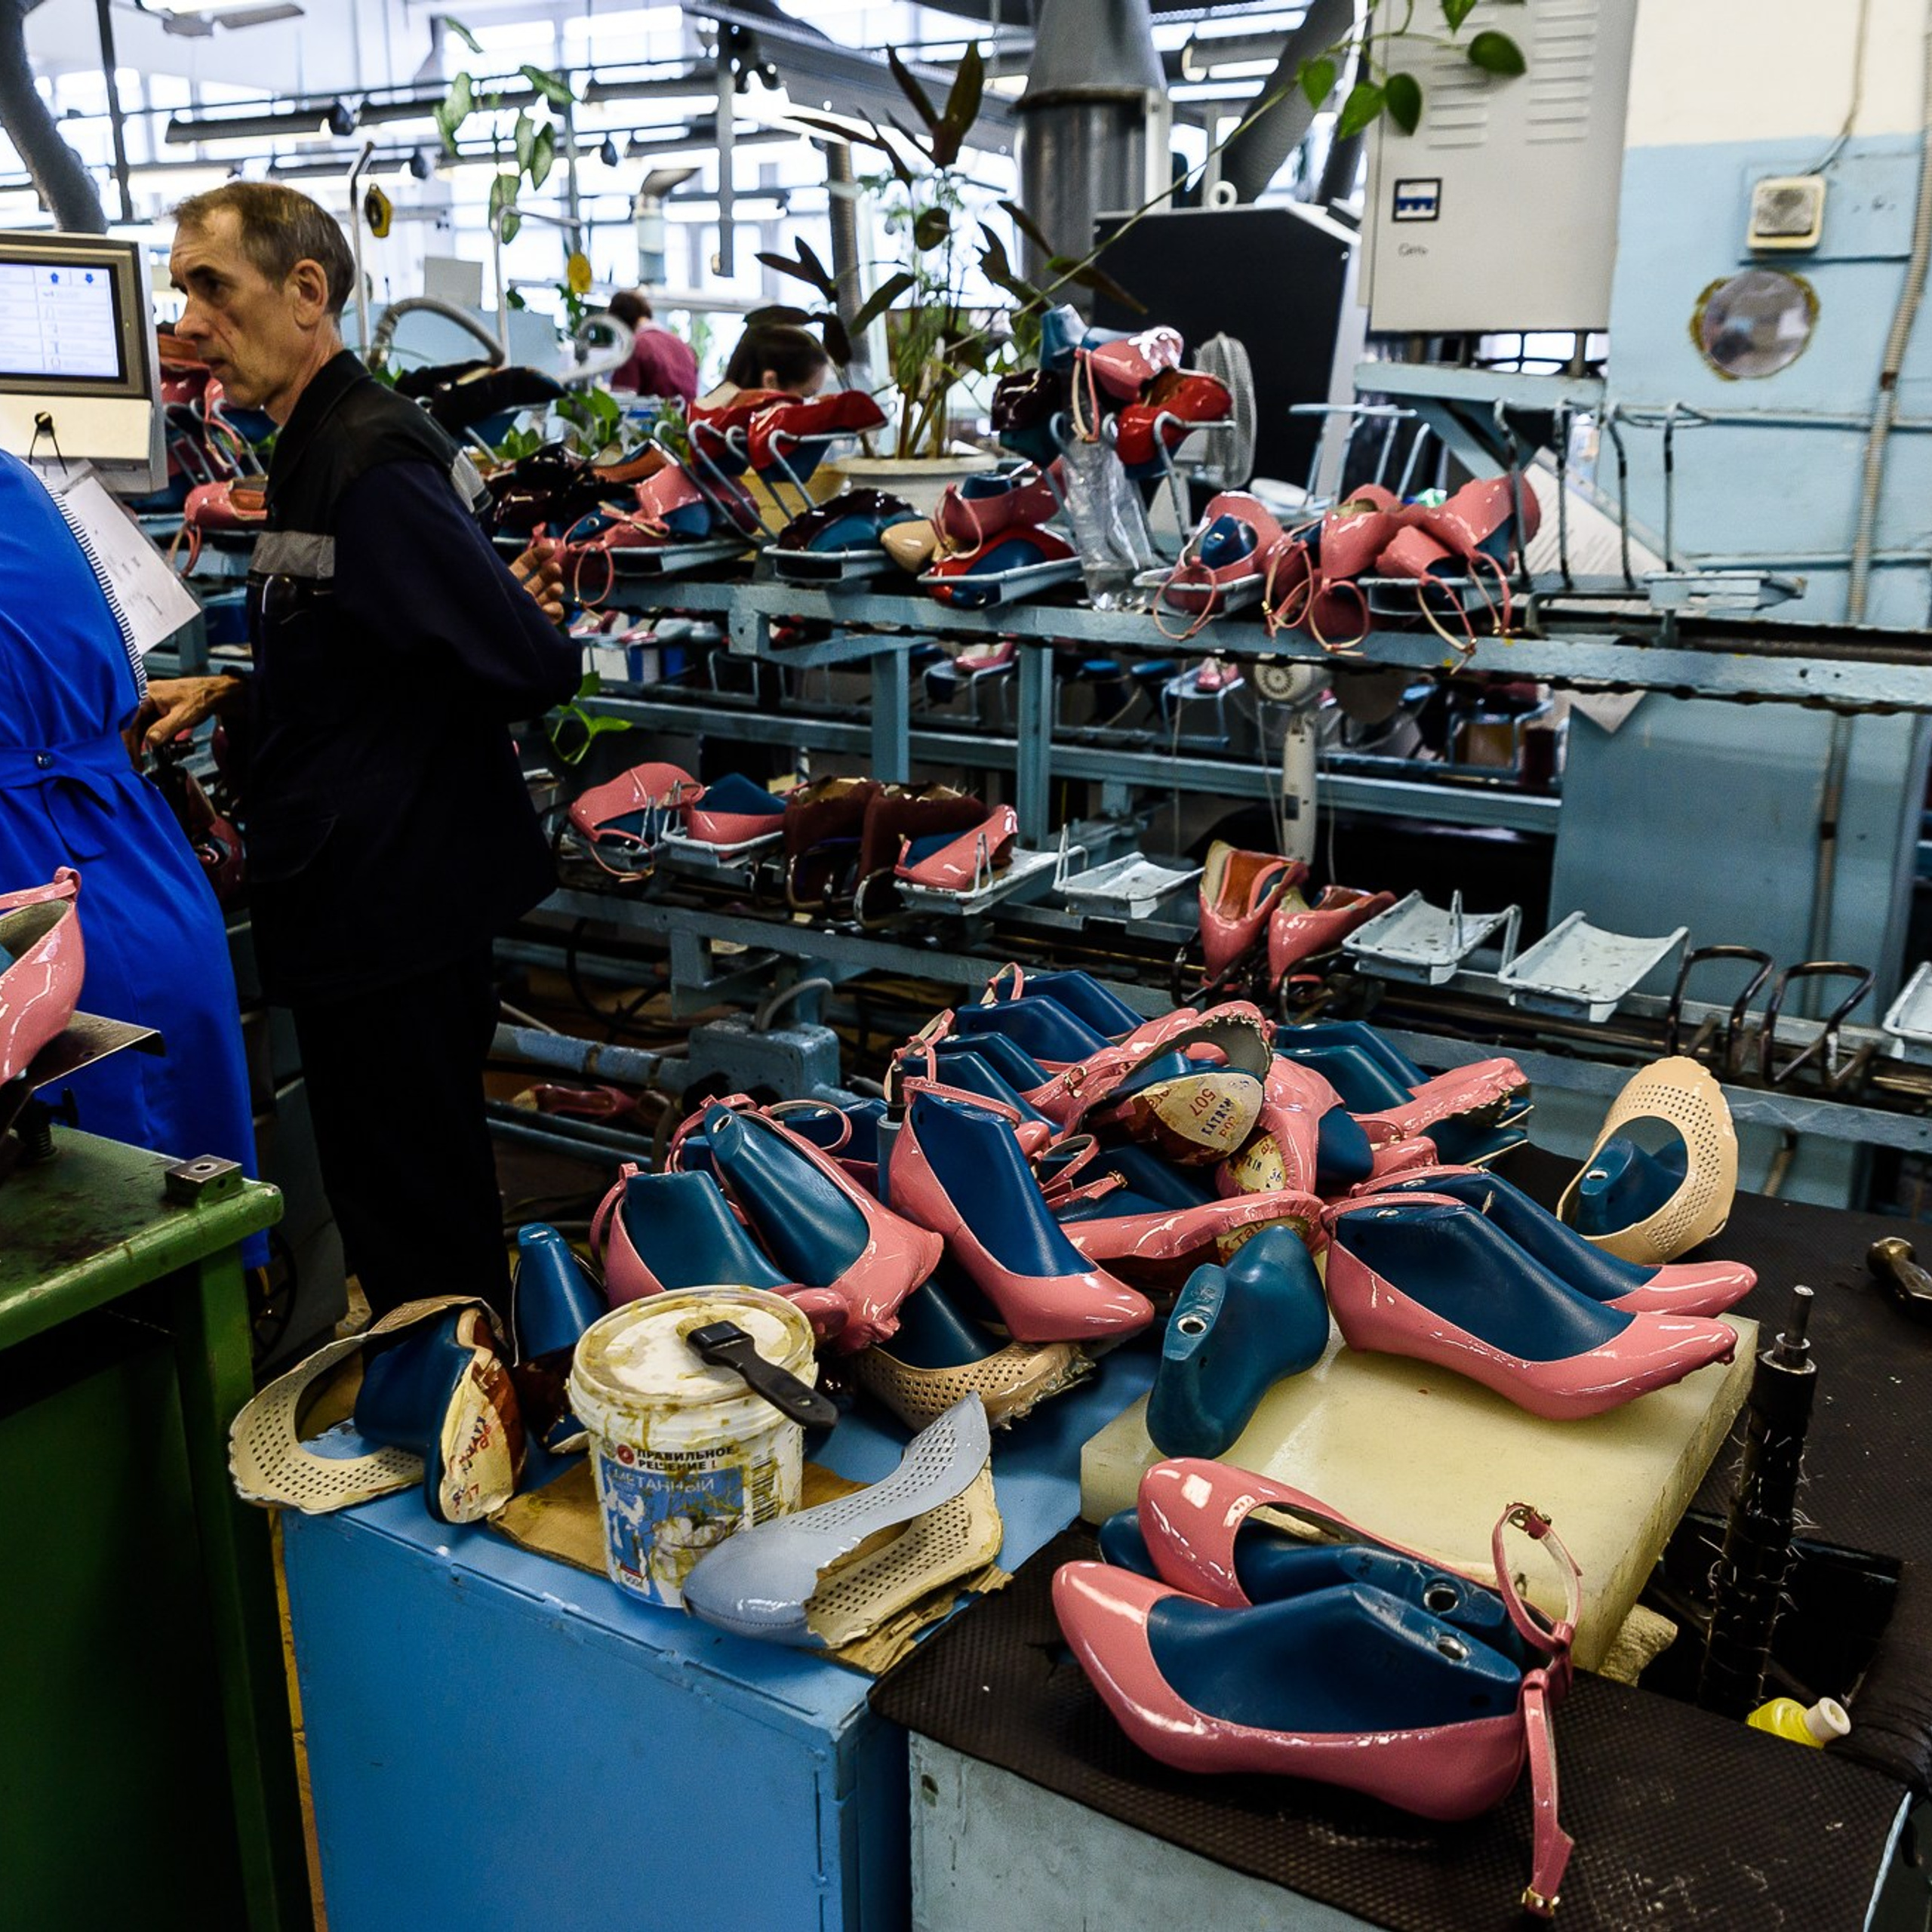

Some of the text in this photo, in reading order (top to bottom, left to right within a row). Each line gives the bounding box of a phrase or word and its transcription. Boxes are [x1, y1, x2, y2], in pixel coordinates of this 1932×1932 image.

[1189, 1088, 1216, 1116] 507
[637, 1444, 735, 1462] ПРАВИЛЬНОЕ
[638, 1460, 706, 1472] РЕШЕНИЕ
